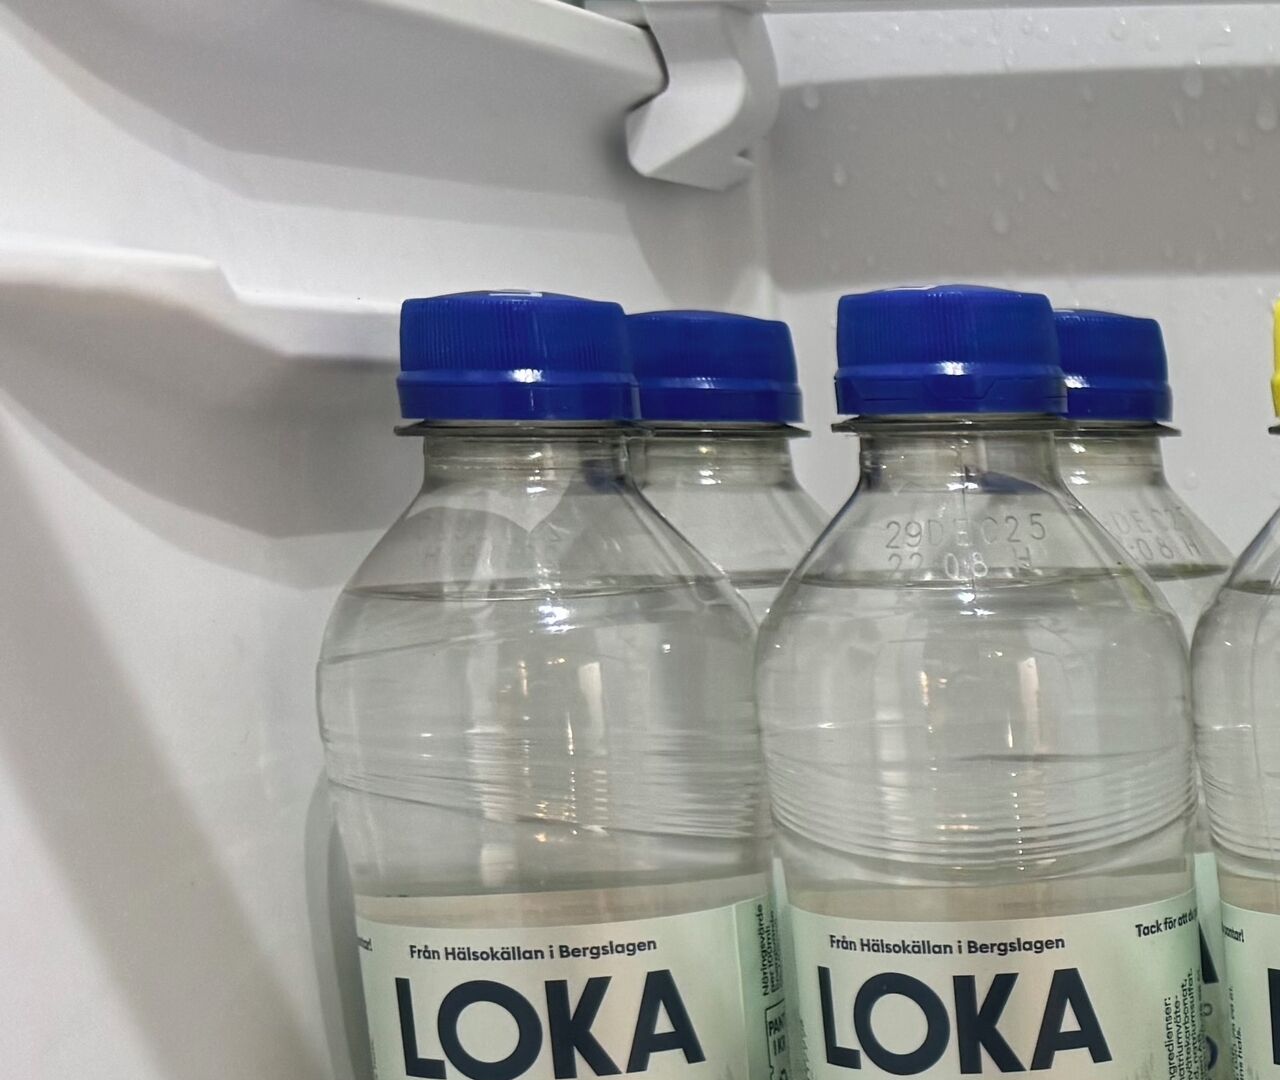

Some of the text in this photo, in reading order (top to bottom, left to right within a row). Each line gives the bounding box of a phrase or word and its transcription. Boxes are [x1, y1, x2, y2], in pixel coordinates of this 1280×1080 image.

[1135, 919, 1162, 938] Tack
[409, 938, 657, 962] Från Hälsokällan i Bergslagen
[756, 903, 769, 996] Näringsvärde
[829, 934, 1065, 957] Från Hälsokällan i Bergslagen
[817, 966, 1113, 1076] LOKA
